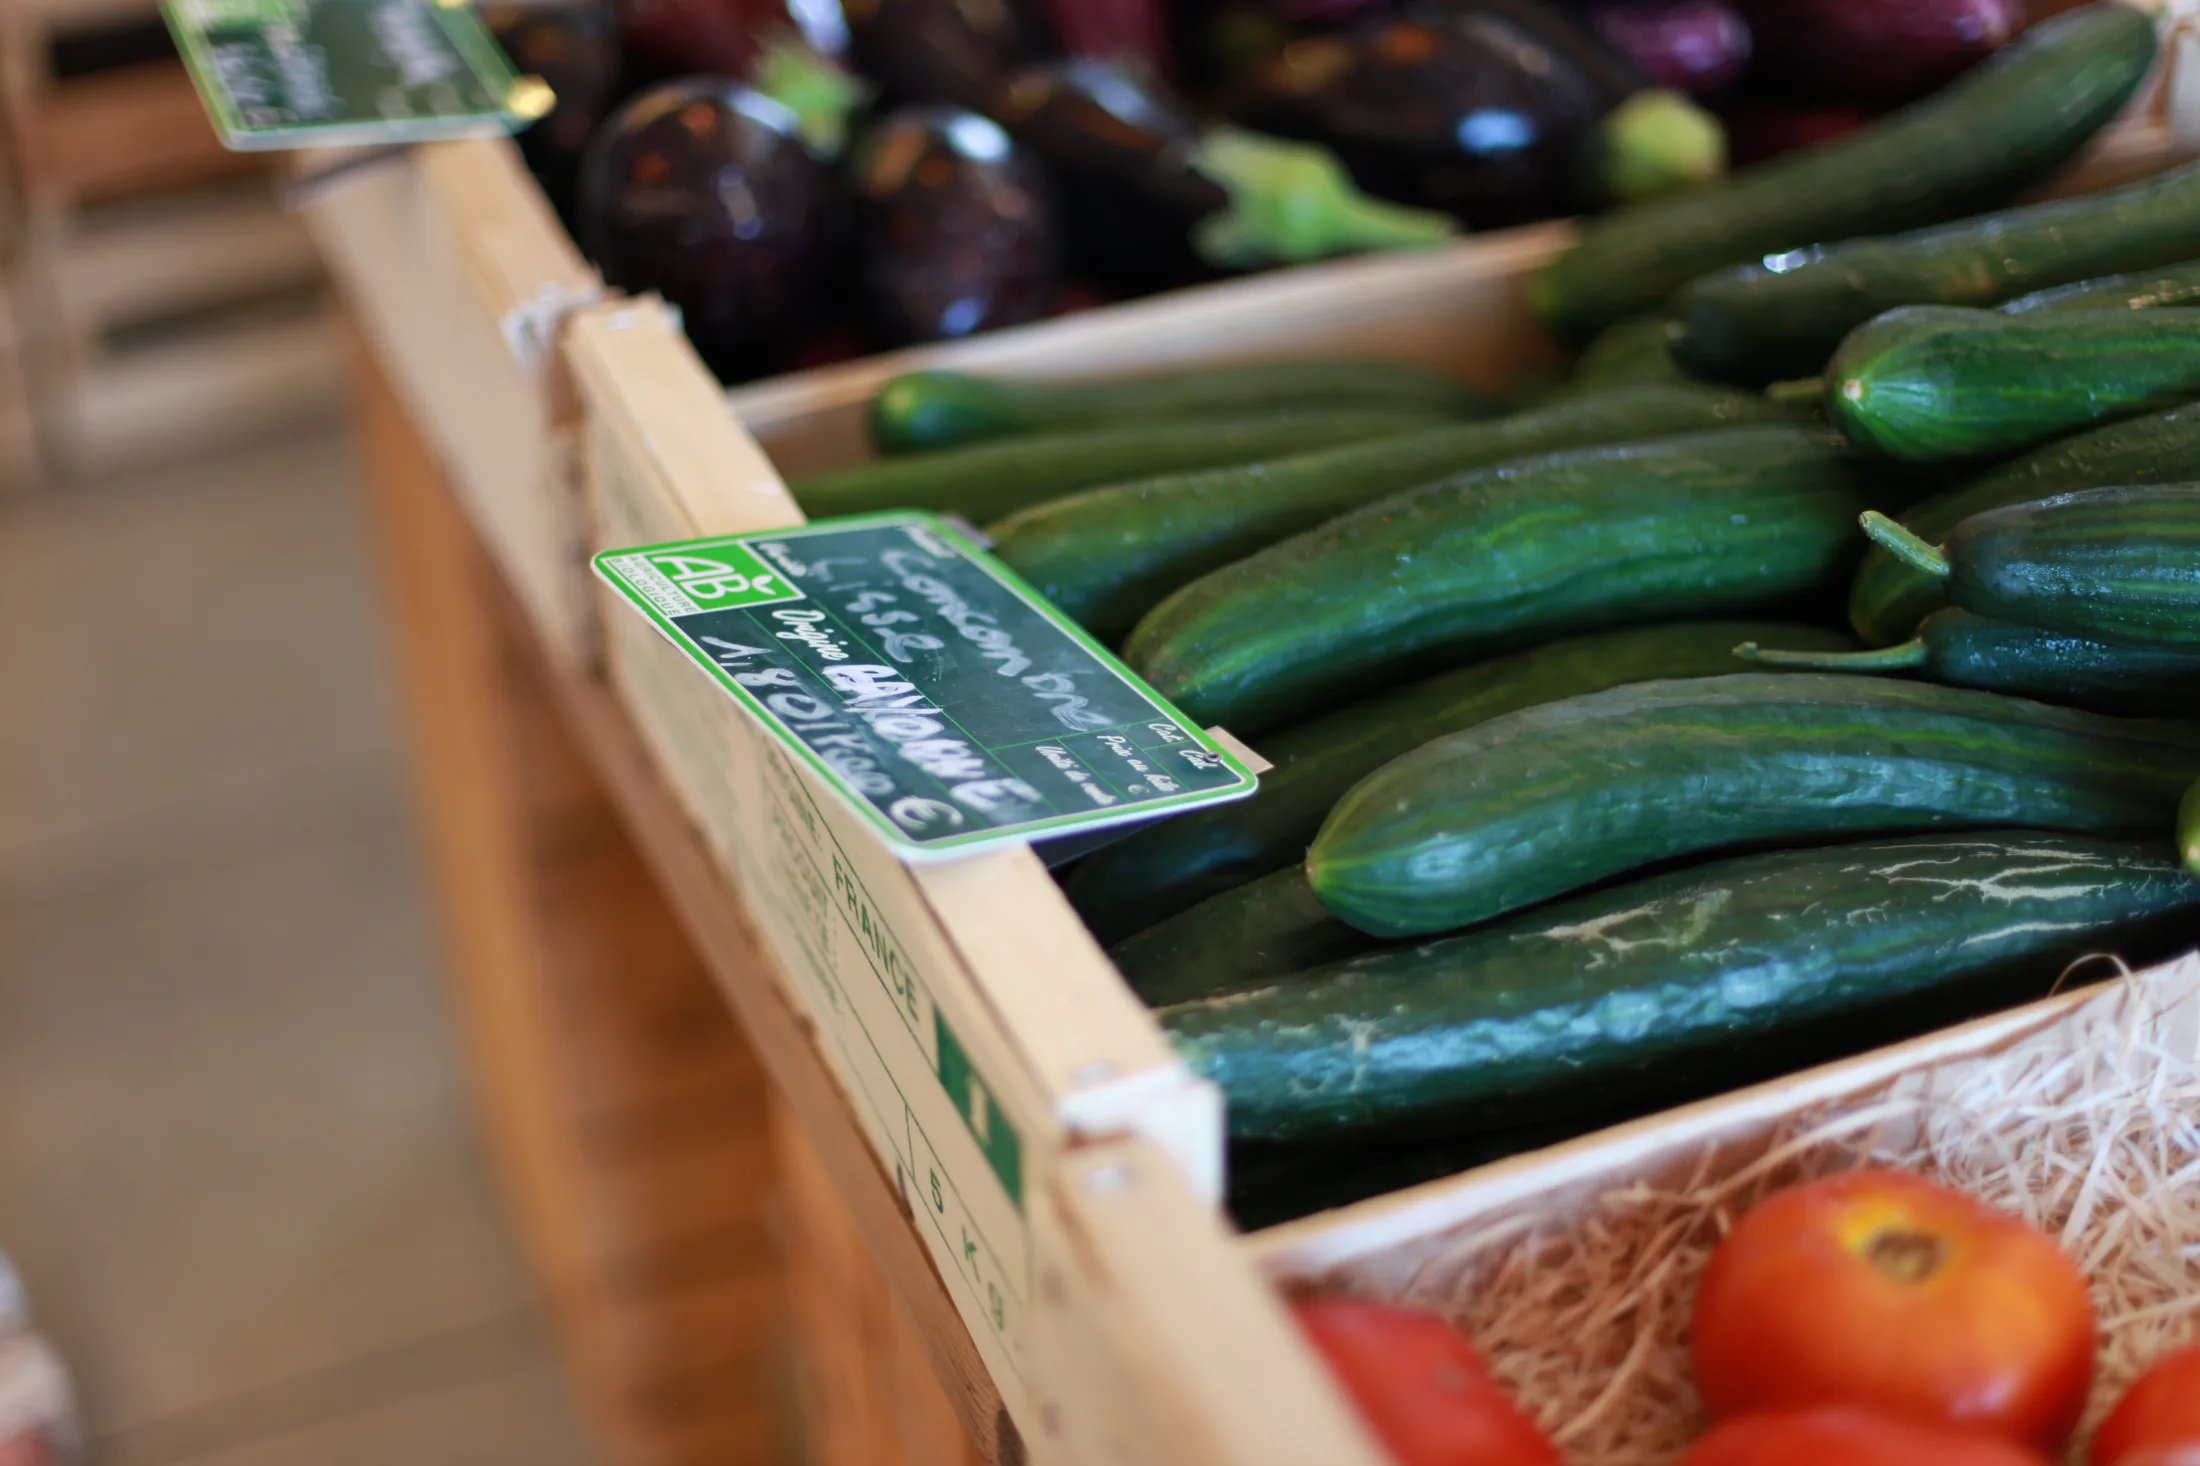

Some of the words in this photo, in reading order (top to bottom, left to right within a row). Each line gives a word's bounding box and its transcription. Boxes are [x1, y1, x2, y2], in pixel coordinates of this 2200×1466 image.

[610, 557, 681, 616] BIOLOGIQUE
[629, 555, 698, 613] AGRICULTURE
[652, 555, 751, 600] AB
[771, 609, 850, 661] Origine
[821, 664, 1042, 812] BAYONNE
[1147, 723, 1185, 743] Cat.
[1096, 735, 1134, 757] Prix
[1126, 758, 1149, 773] au
[832, 852, 919, 1023] FRANCE
[929, 1167, 944, 1215] 5
